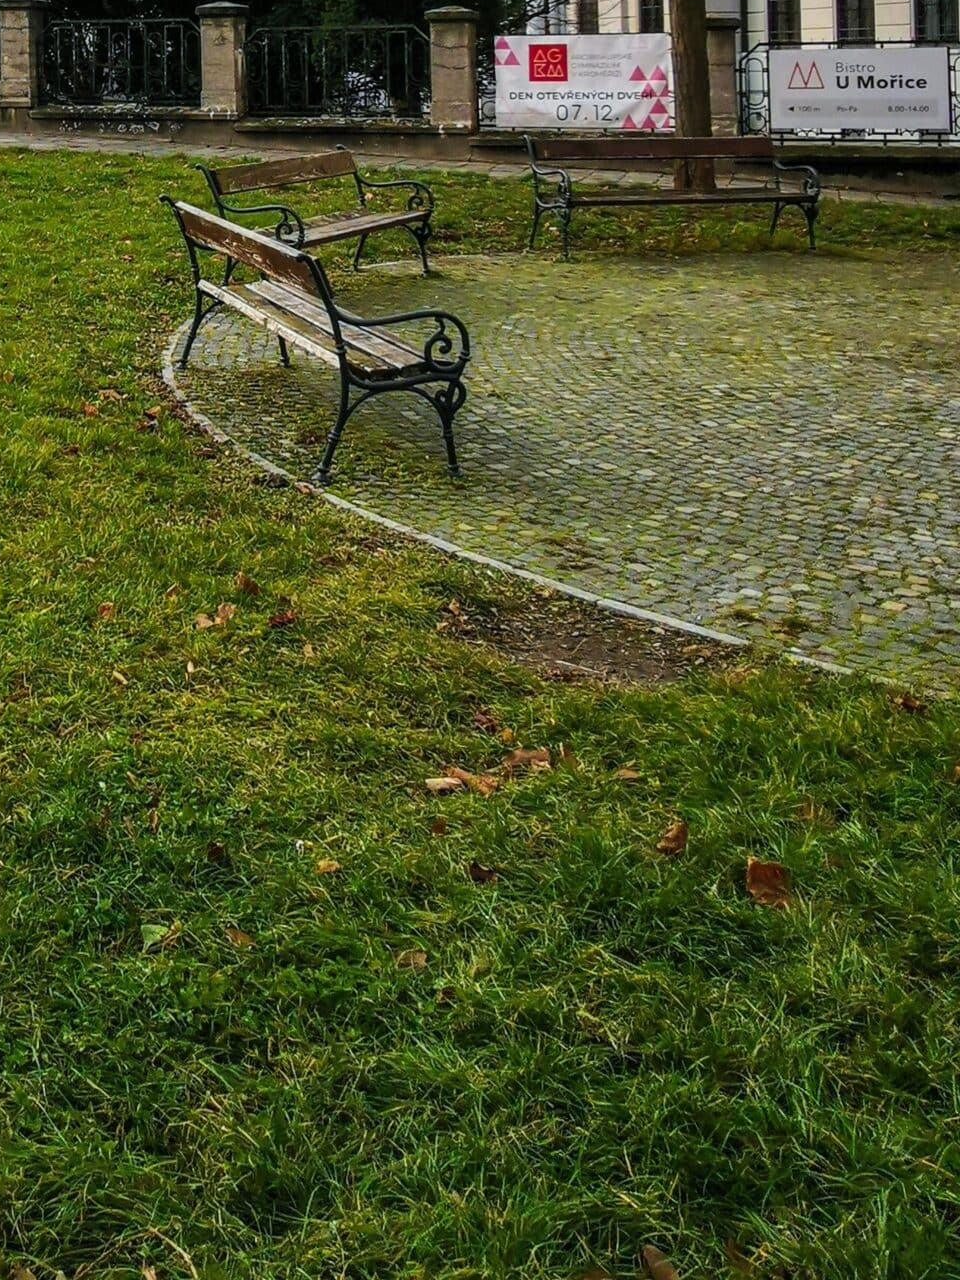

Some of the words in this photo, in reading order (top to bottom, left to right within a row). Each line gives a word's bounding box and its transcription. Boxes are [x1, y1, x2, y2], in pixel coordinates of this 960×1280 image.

[835, 62, 876, 73] Bistro
[836, 76, 850, 89] U
[857, 74, 928, 89] Mořice
[509, 91, 533, 101] DEN
[536, 90, 614, 101] OTEVŘENÝCH
